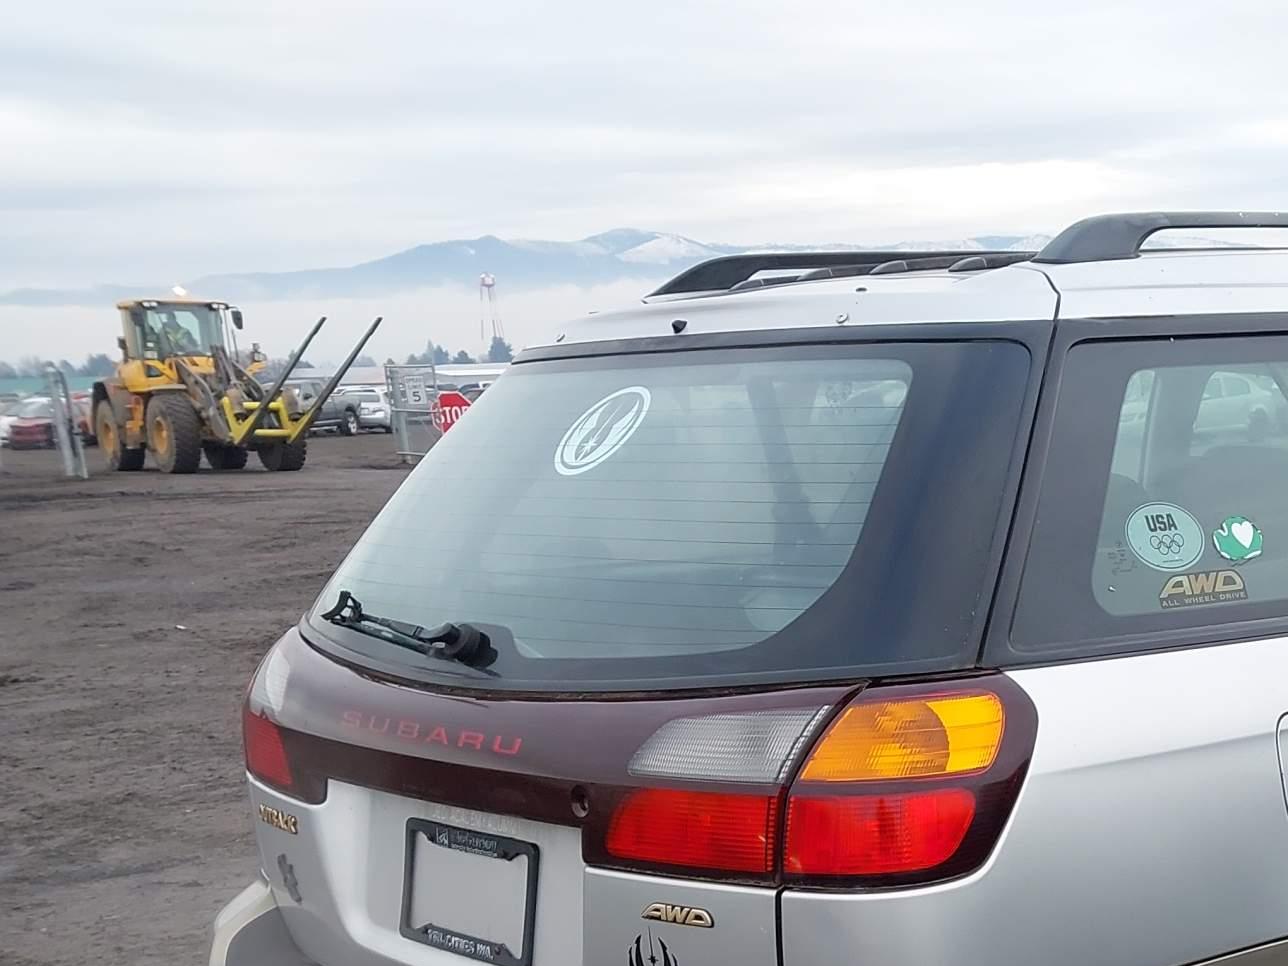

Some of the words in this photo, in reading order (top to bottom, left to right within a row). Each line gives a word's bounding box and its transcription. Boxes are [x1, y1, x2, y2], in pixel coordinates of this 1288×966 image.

[412, 391, 421, 402] 5
[1145, 513, 1178, 533] USA
[1160, 570, 1244, 599] AWD
[1162, 600, 1181, 608] ALL
[1184, 595, 1217, 605] WHEEL
[1219, 591, 1247, 600] DRIVE
[341, 709, 523, 755] SUBARU
[640, 902, 713, 928] AWD
